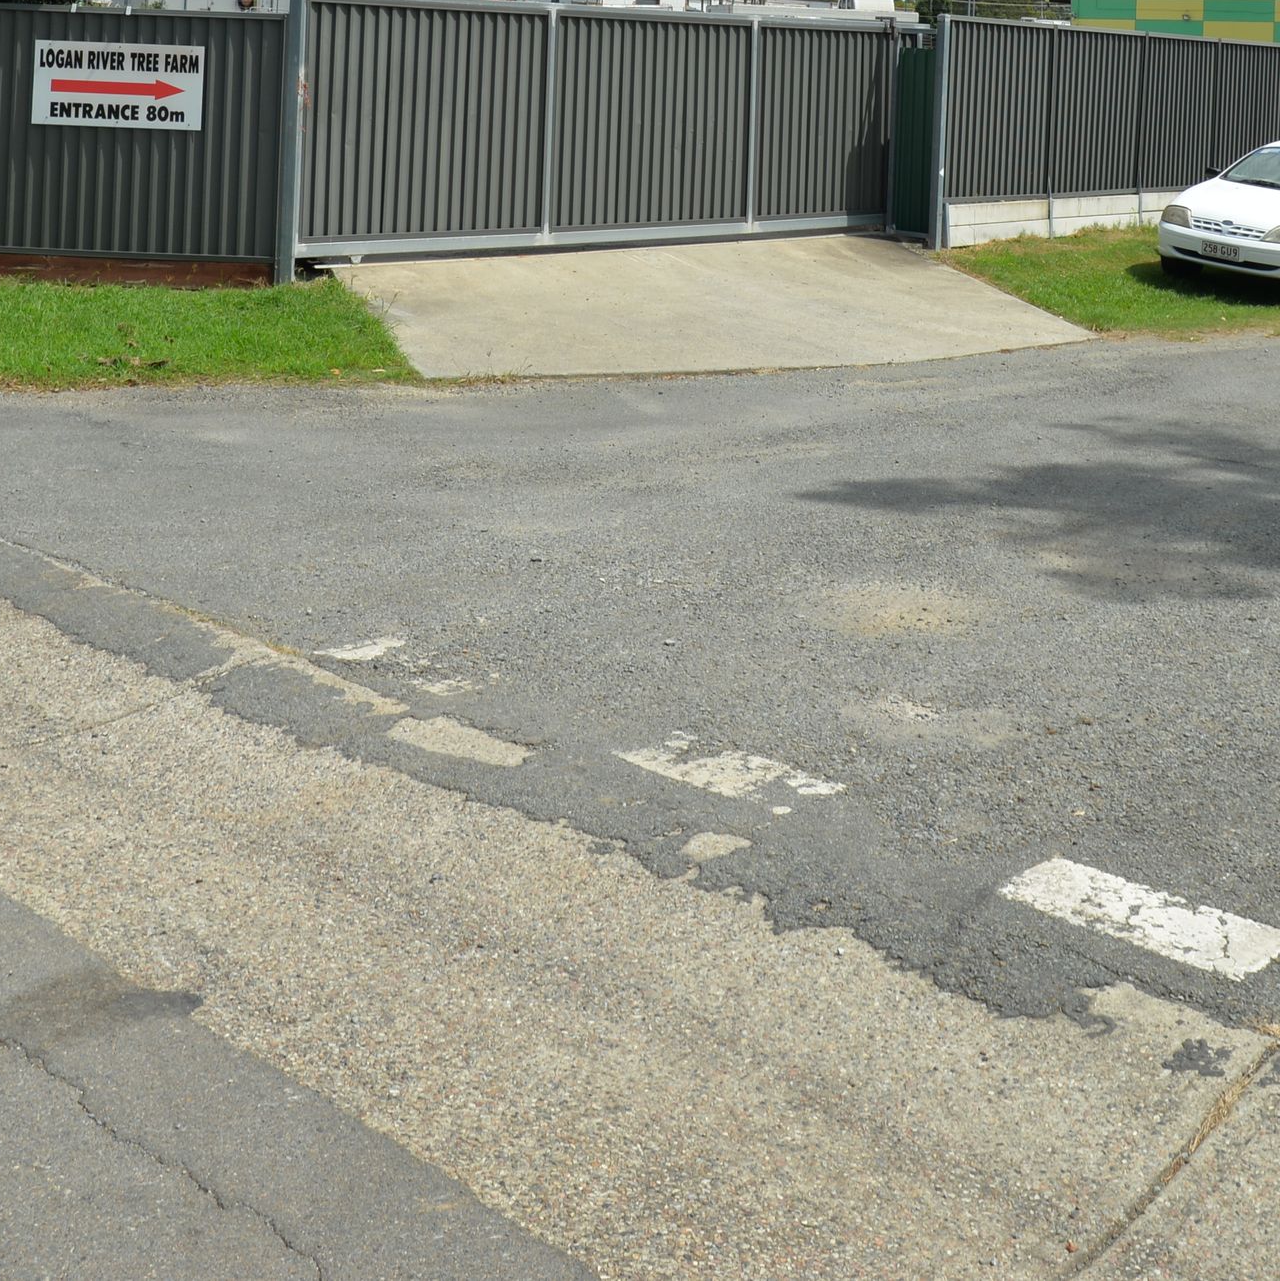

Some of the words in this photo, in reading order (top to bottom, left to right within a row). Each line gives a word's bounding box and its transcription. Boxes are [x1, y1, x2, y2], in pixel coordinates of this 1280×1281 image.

[39, 48, 83, 69] LOGAN
[87, 50, 125, 71] RIVER
[130, 52, 159, 72] TREE
[164, 54, 199, 74] FARM
[49, 101, 139, 121] ENTRANCE
[146, 106, 185, 123] 80m
